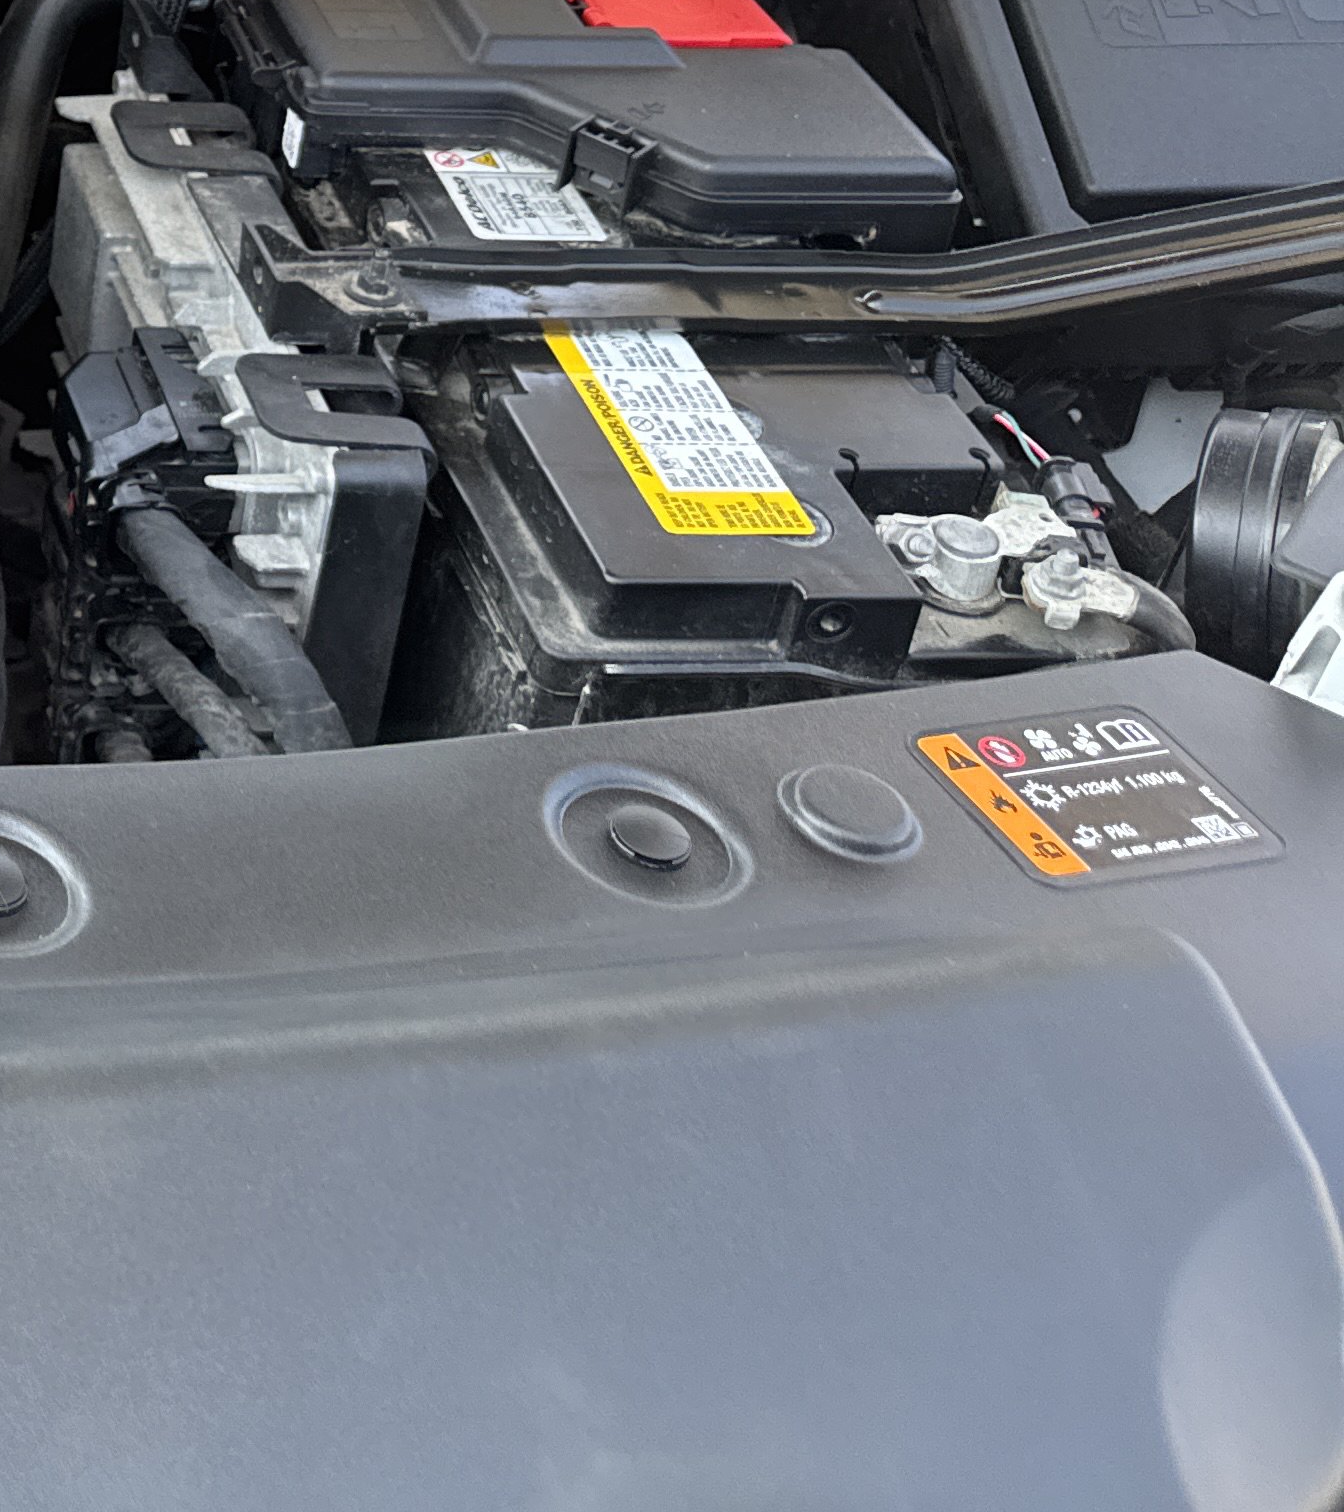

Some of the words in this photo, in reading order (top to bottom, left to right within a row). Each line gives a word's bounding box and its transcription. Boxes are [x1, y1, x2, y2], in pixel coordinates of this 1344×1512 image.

[1040, 747, 1074, 762] AUTO
[1124, 771, 1165, 790] 1.100
[1103, 821, 1140, 841] PAG
